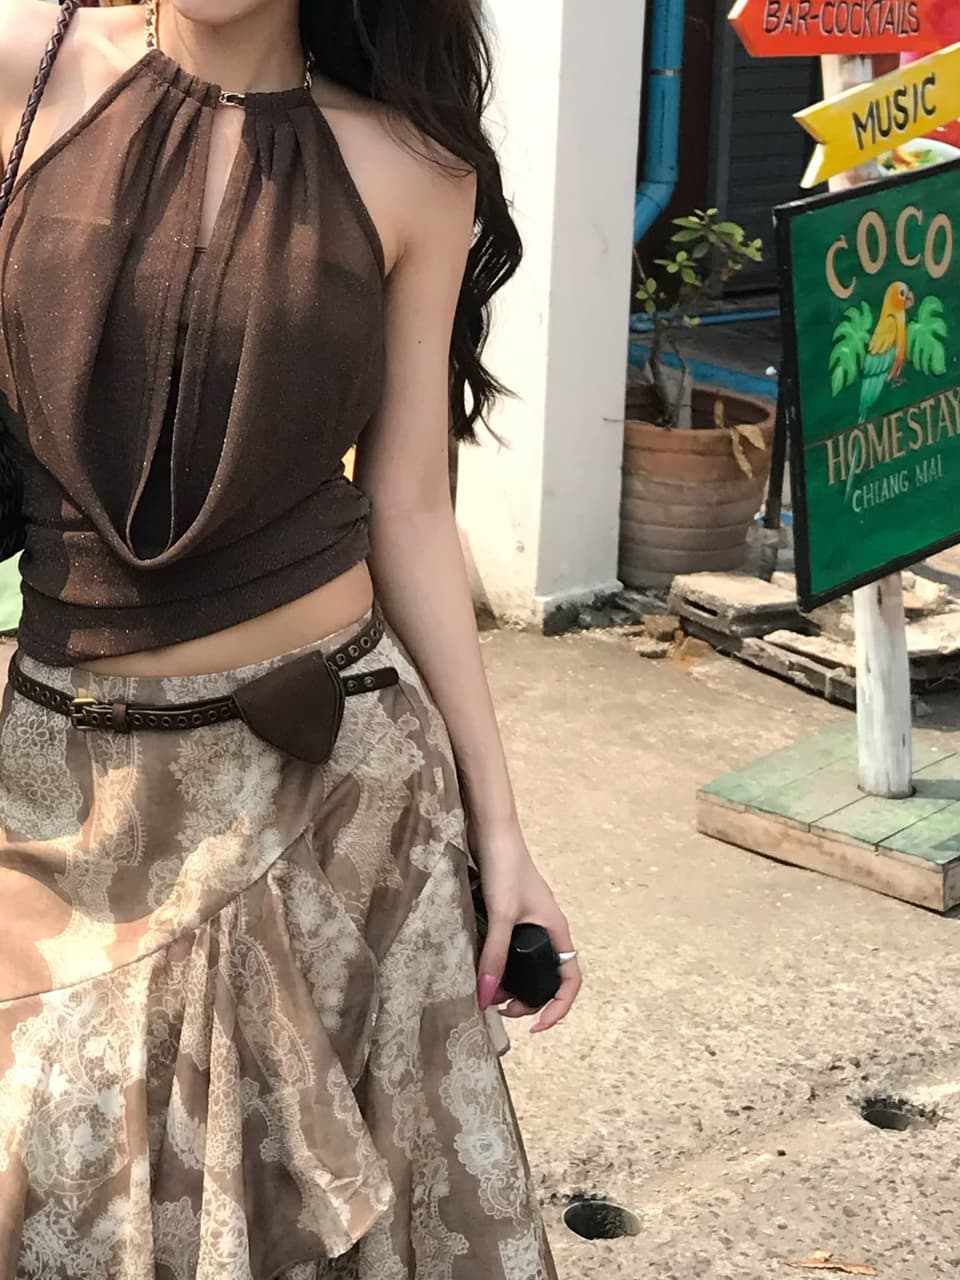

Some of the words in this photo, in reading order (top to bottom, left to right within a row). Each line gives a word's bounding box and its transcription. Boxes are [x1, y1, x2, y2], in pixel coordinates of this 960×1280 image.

[851, 72, 937, 151] MUSIC
[825, 204, 954, 300] COCO
[824, 387, 960, 486] HOMESTAY
[851, 469, 909, 513] CHIANG
[915, 453, 943, 487] MAI
